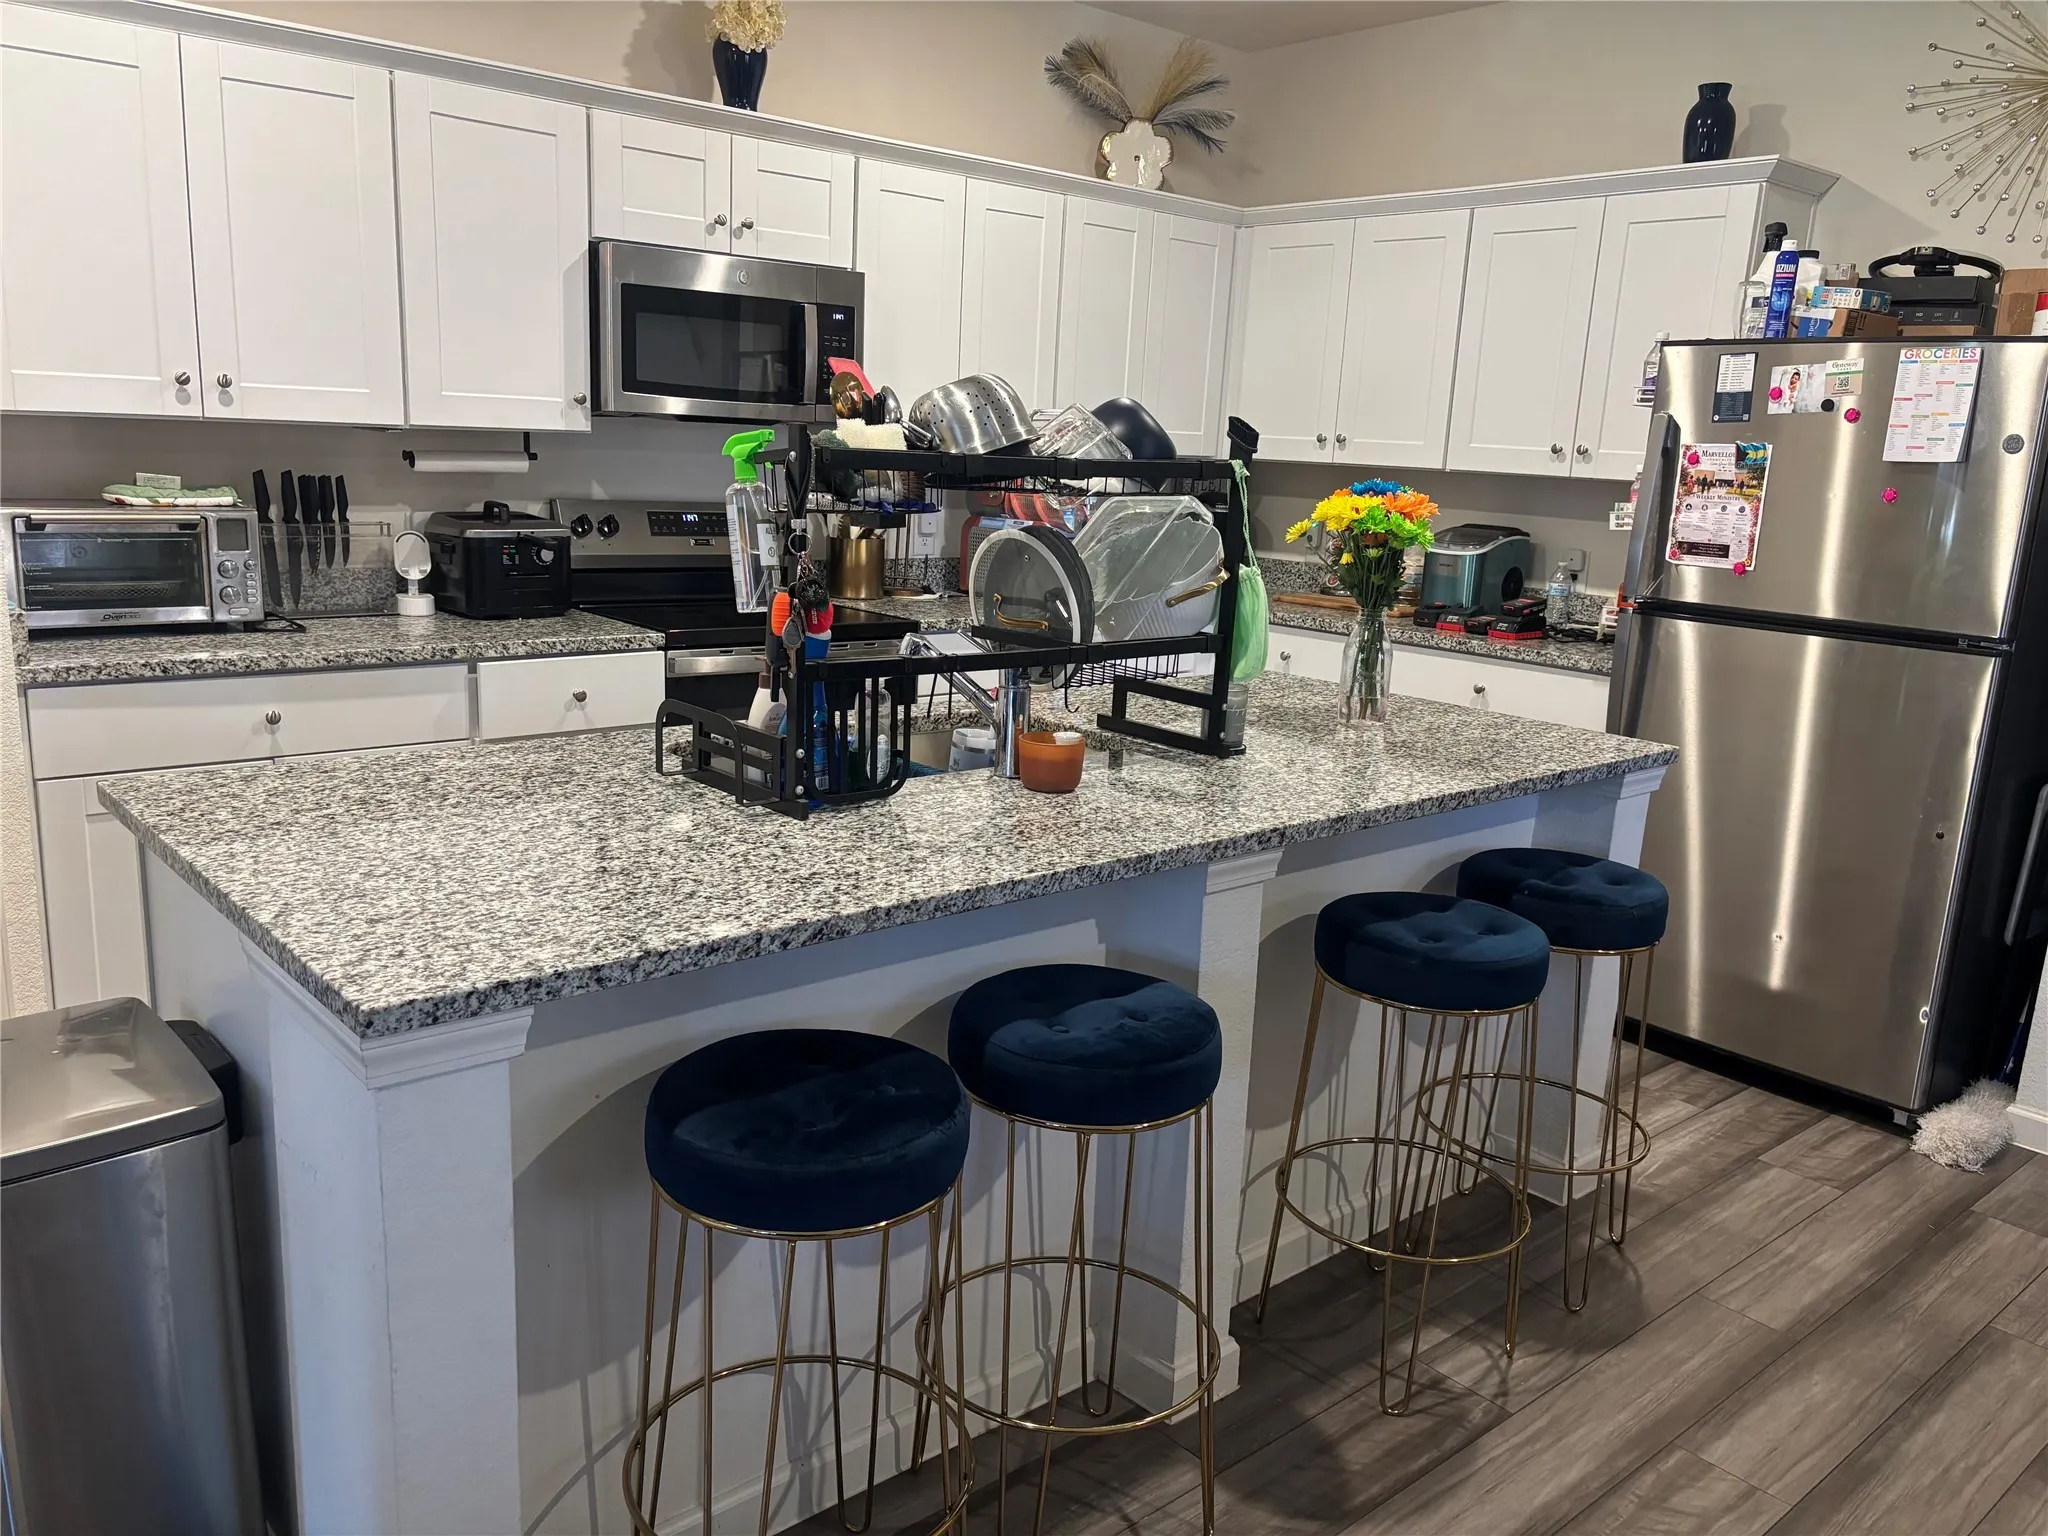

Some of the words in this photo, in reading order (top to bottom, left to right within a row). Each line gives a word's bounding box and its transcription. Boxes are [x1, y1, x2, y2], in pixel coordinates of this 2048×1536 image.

[1775, 264, 1797, 273] OZIUM
[1904, 348, 1977, 359] GROCERIES
[1832, 361, 1859, 369] Gateway
